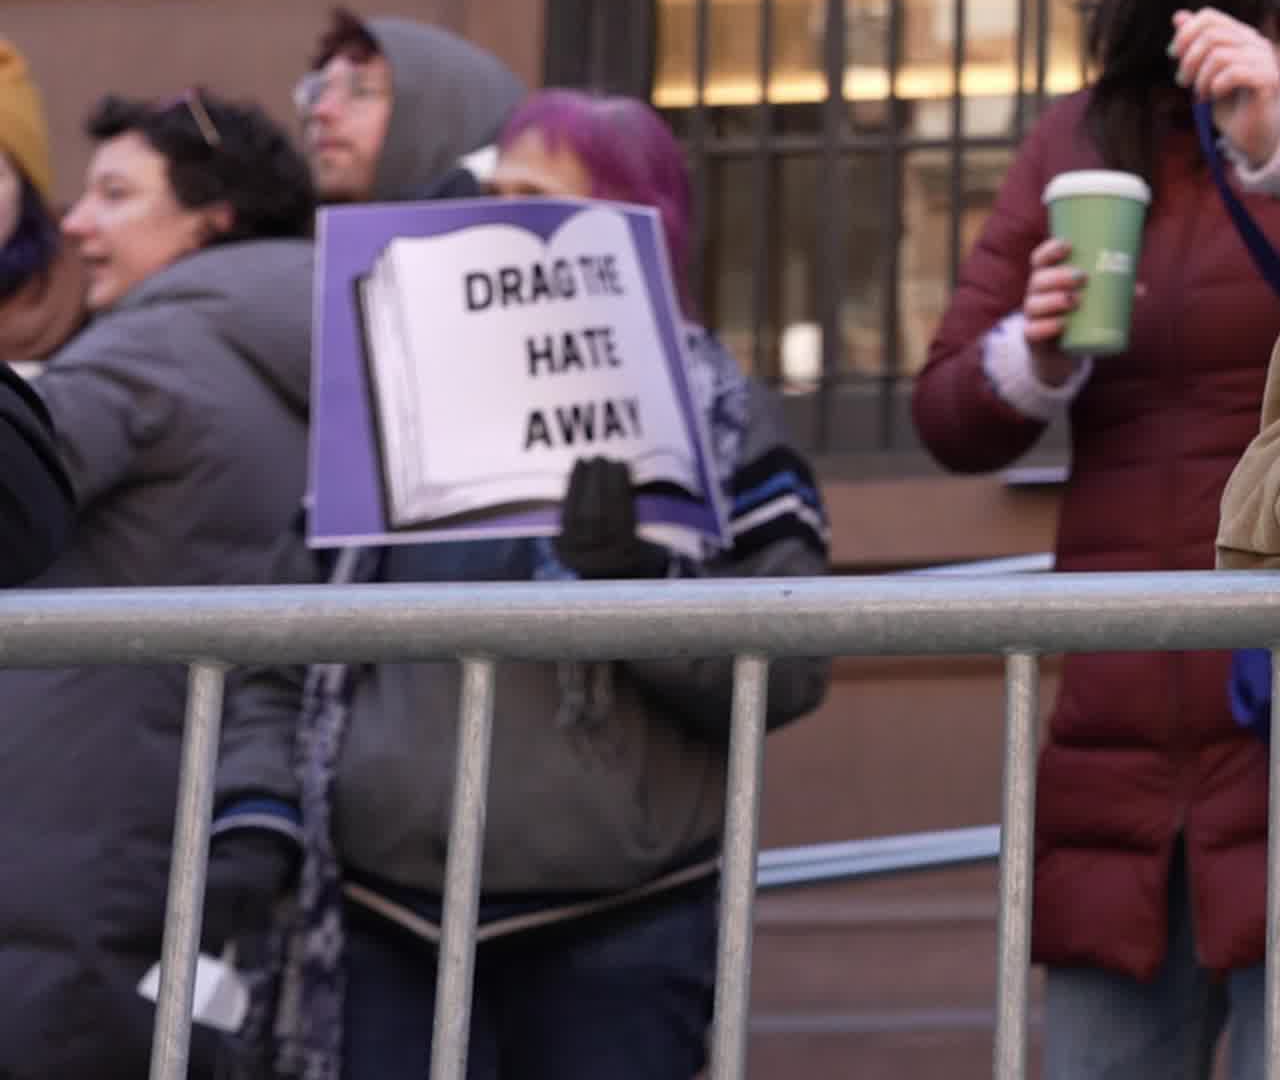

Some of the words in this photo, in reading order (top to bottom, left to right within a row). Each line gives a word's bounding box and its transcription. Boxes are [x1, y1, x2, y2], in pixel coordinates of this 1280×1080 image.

[465, 259, 576, 312] DRAG
[576, 253, 624, 297] THE
[525, 326, 622, 377] HATE
[523, 395, 643, 451] AWAY
